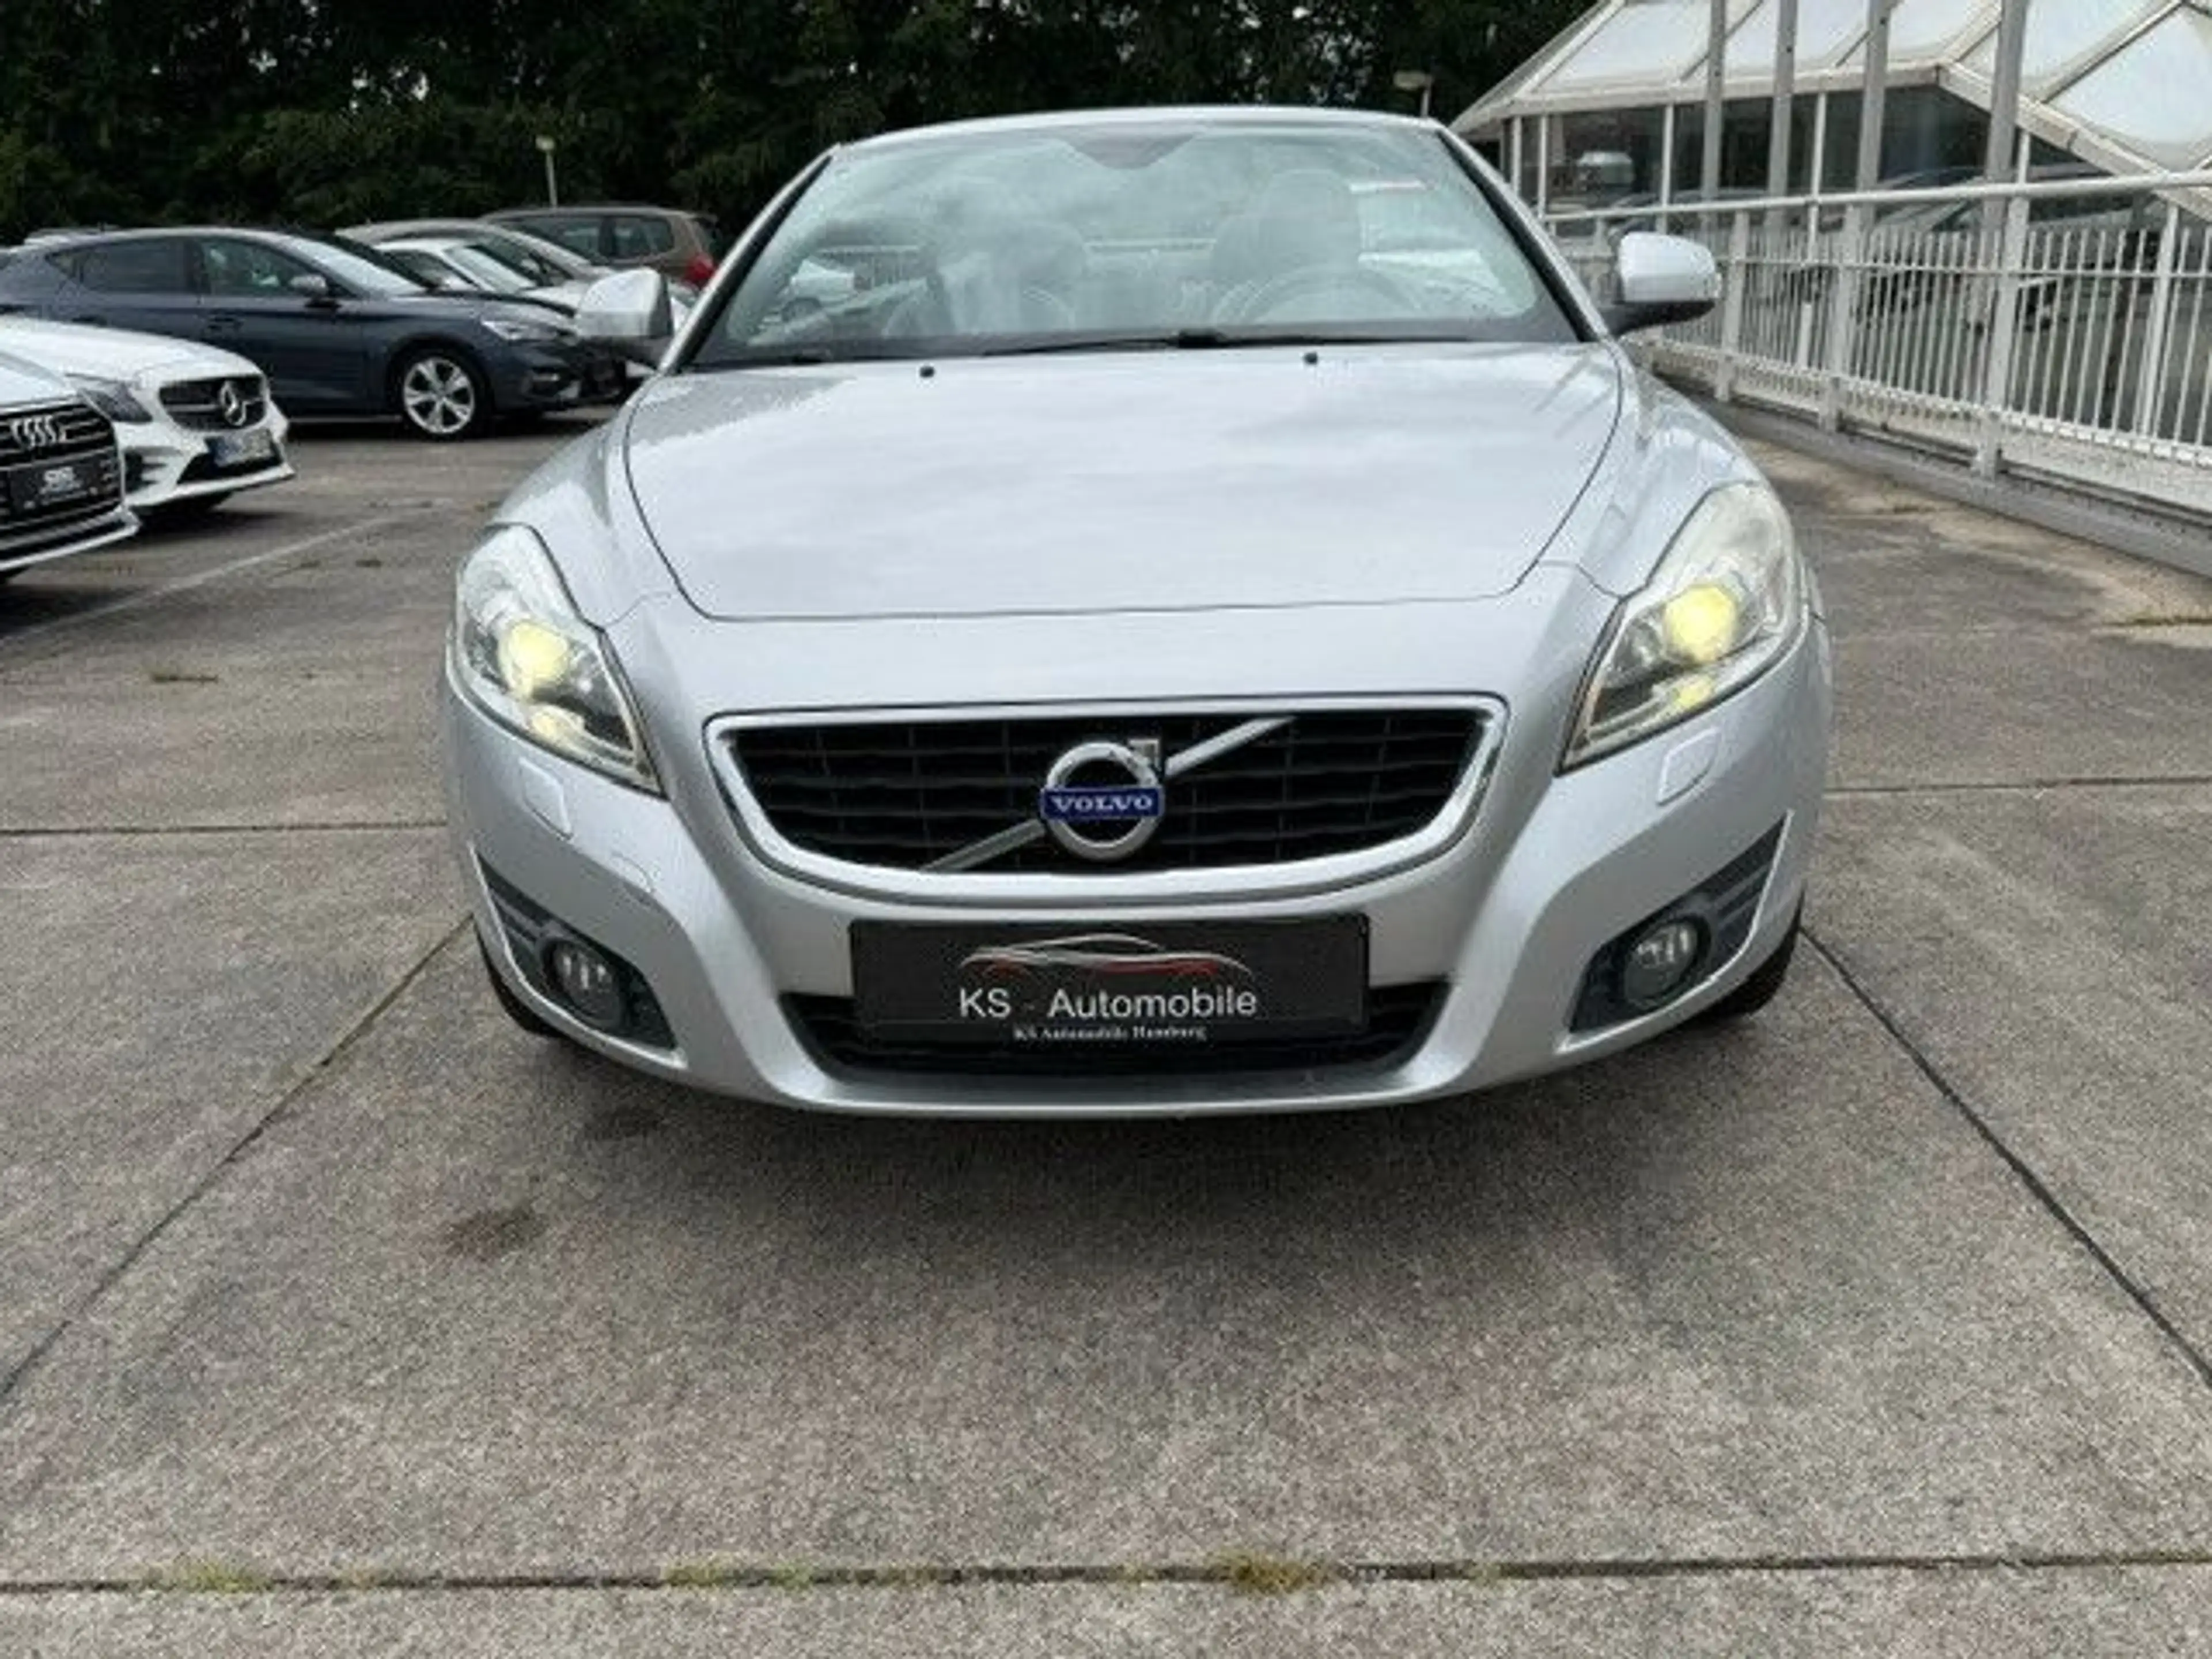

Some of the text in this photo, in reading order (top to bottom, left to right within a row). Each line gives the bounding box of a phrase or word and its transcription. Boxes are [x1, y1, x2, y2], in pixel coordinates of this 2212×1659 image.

[1049, 795, 1153, 812] VOLVO
[960, 987, 1012, 1017] KS
[1046, 985, 1257, 1018] Automobile
